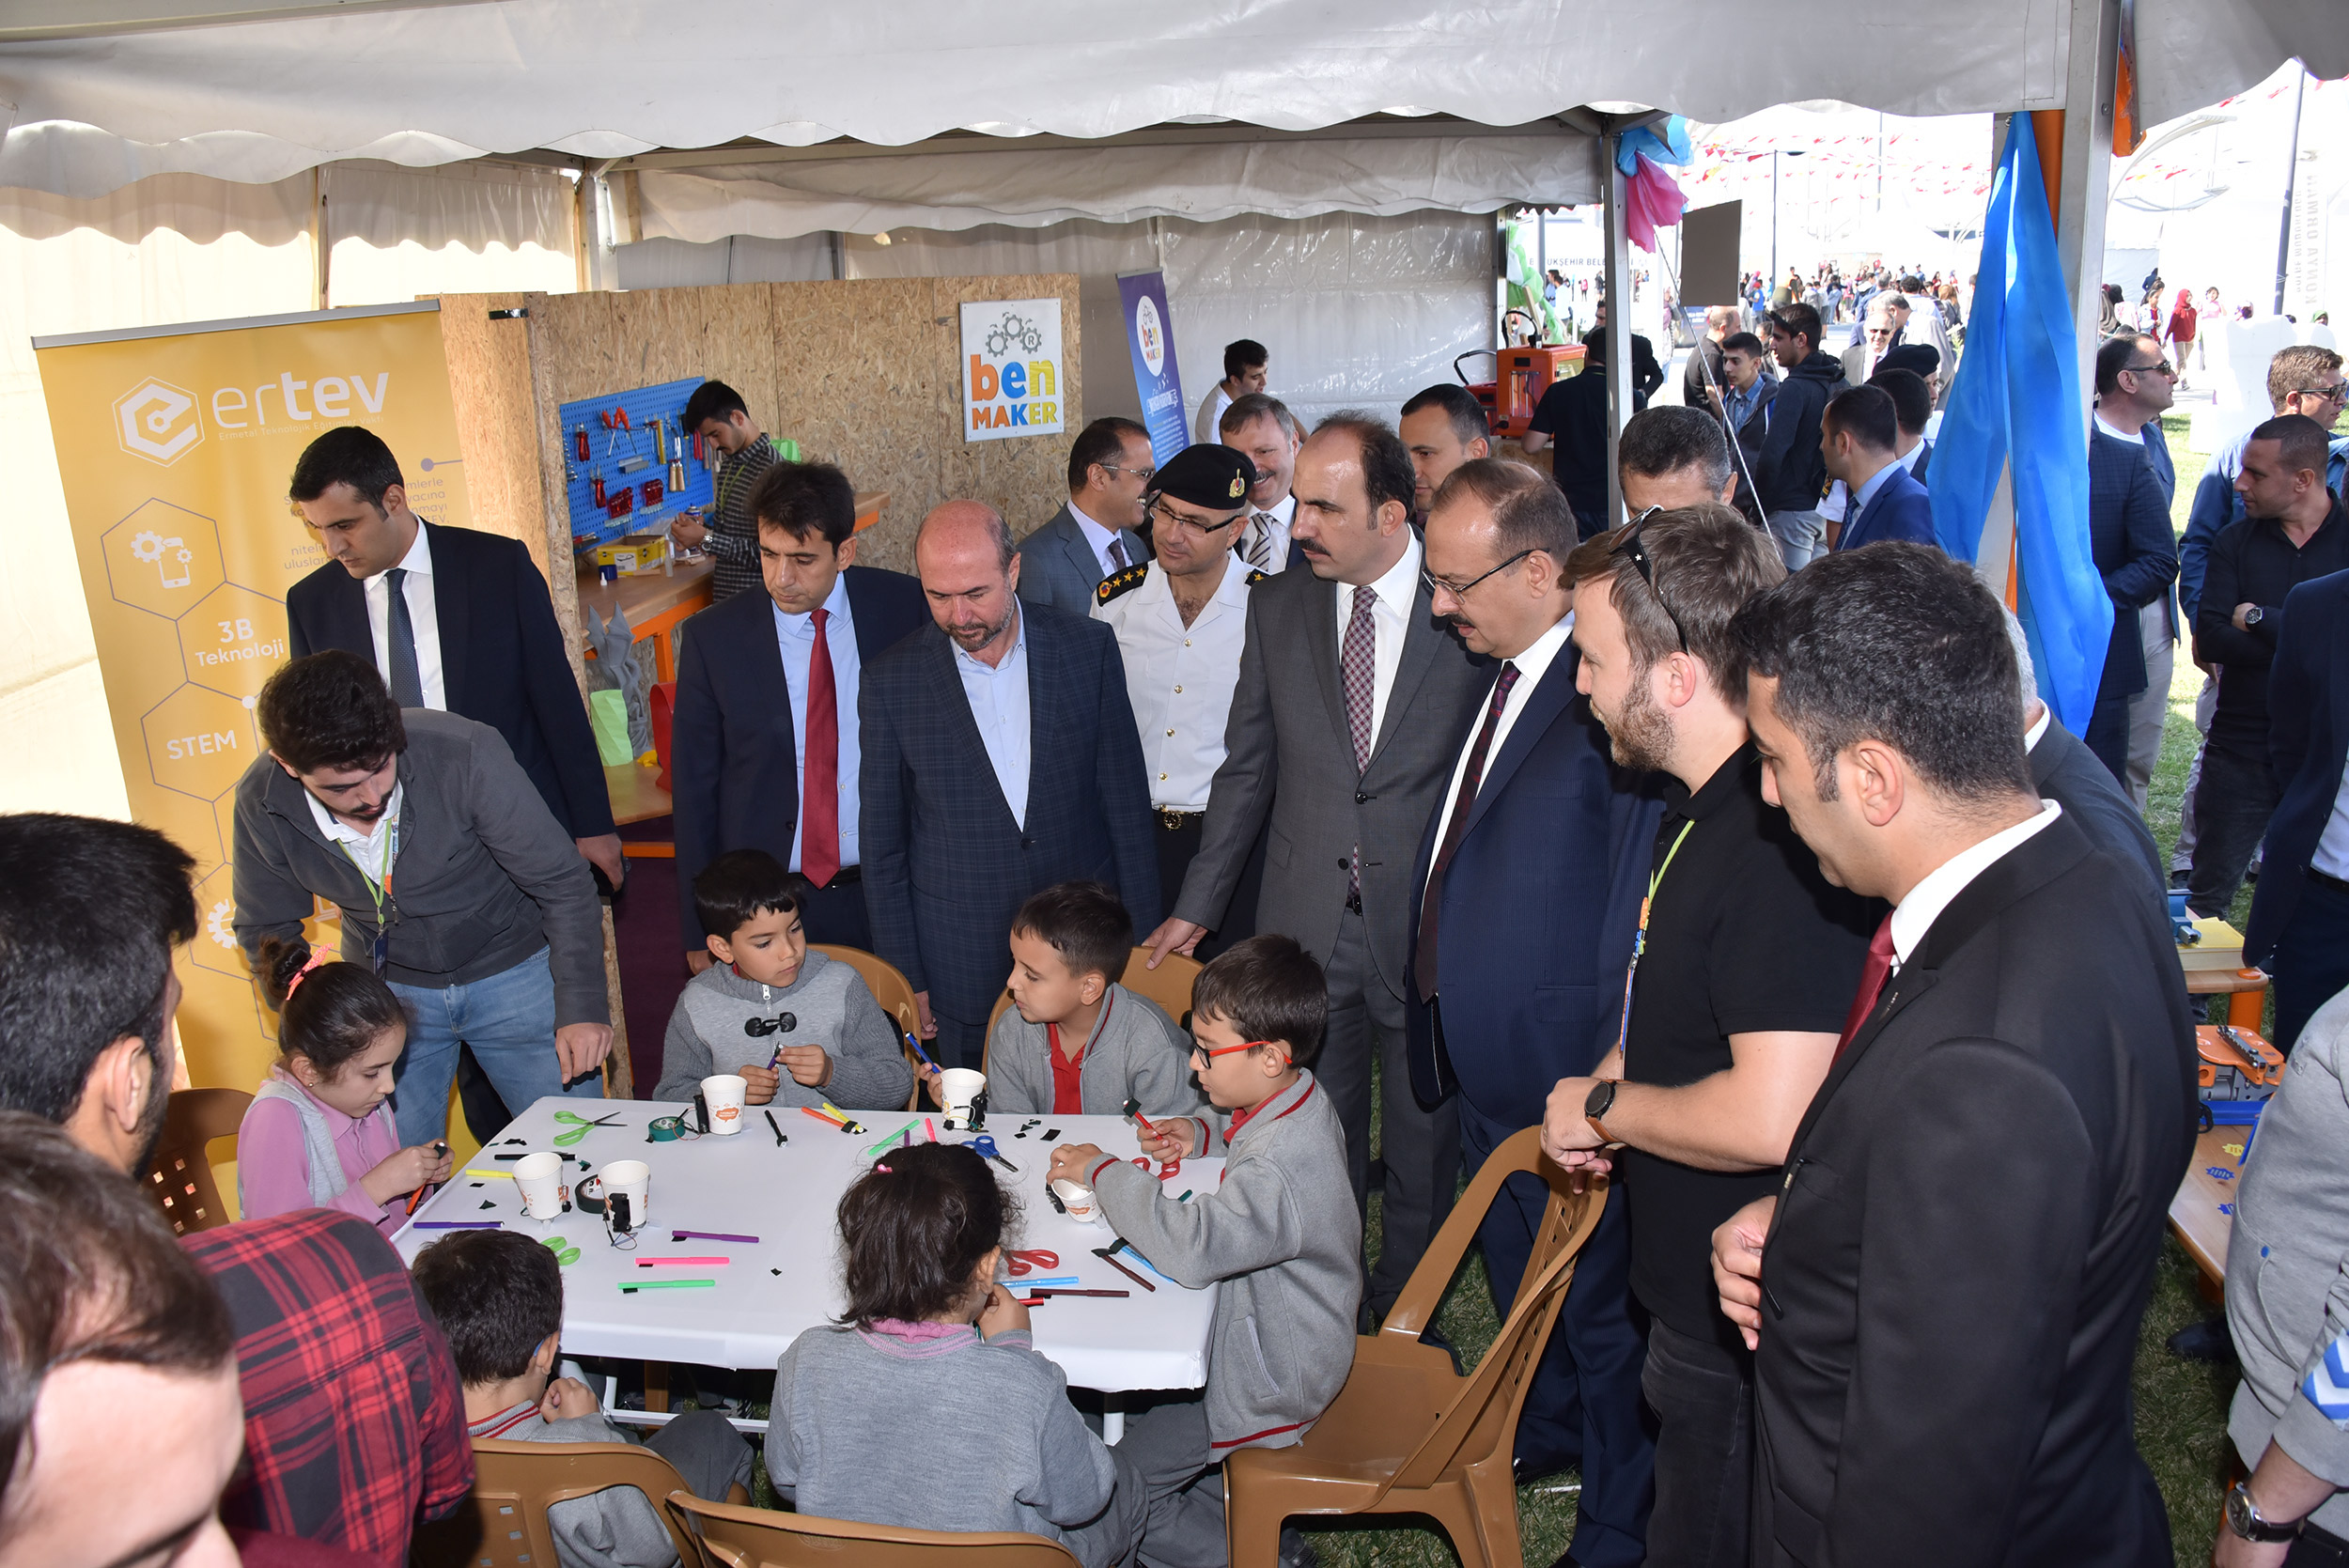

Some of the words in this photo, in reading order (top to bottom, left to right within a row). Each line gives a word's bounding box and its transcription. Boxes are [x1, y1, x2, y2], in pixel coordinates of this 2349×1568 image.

[970, 353, 1056, 402] ben
[212, 371, 389, 428] ertev
[972, 402, 1058, 430] MAKER
[219, 429, 258, 441] Ermetal
[261, 423, 311, 436] Teknolojik
[406, 477, 443, 489] mlerle
[406, 491, 445, 505] yacına
[412, 504, 447, 514] nmayı
[284, 556, 331, 570] uluslar
[218, 618, 254, 643] 3B
[194, 639, 284, 666] Teknoloji
[166, 730, 237, 759] STEM
